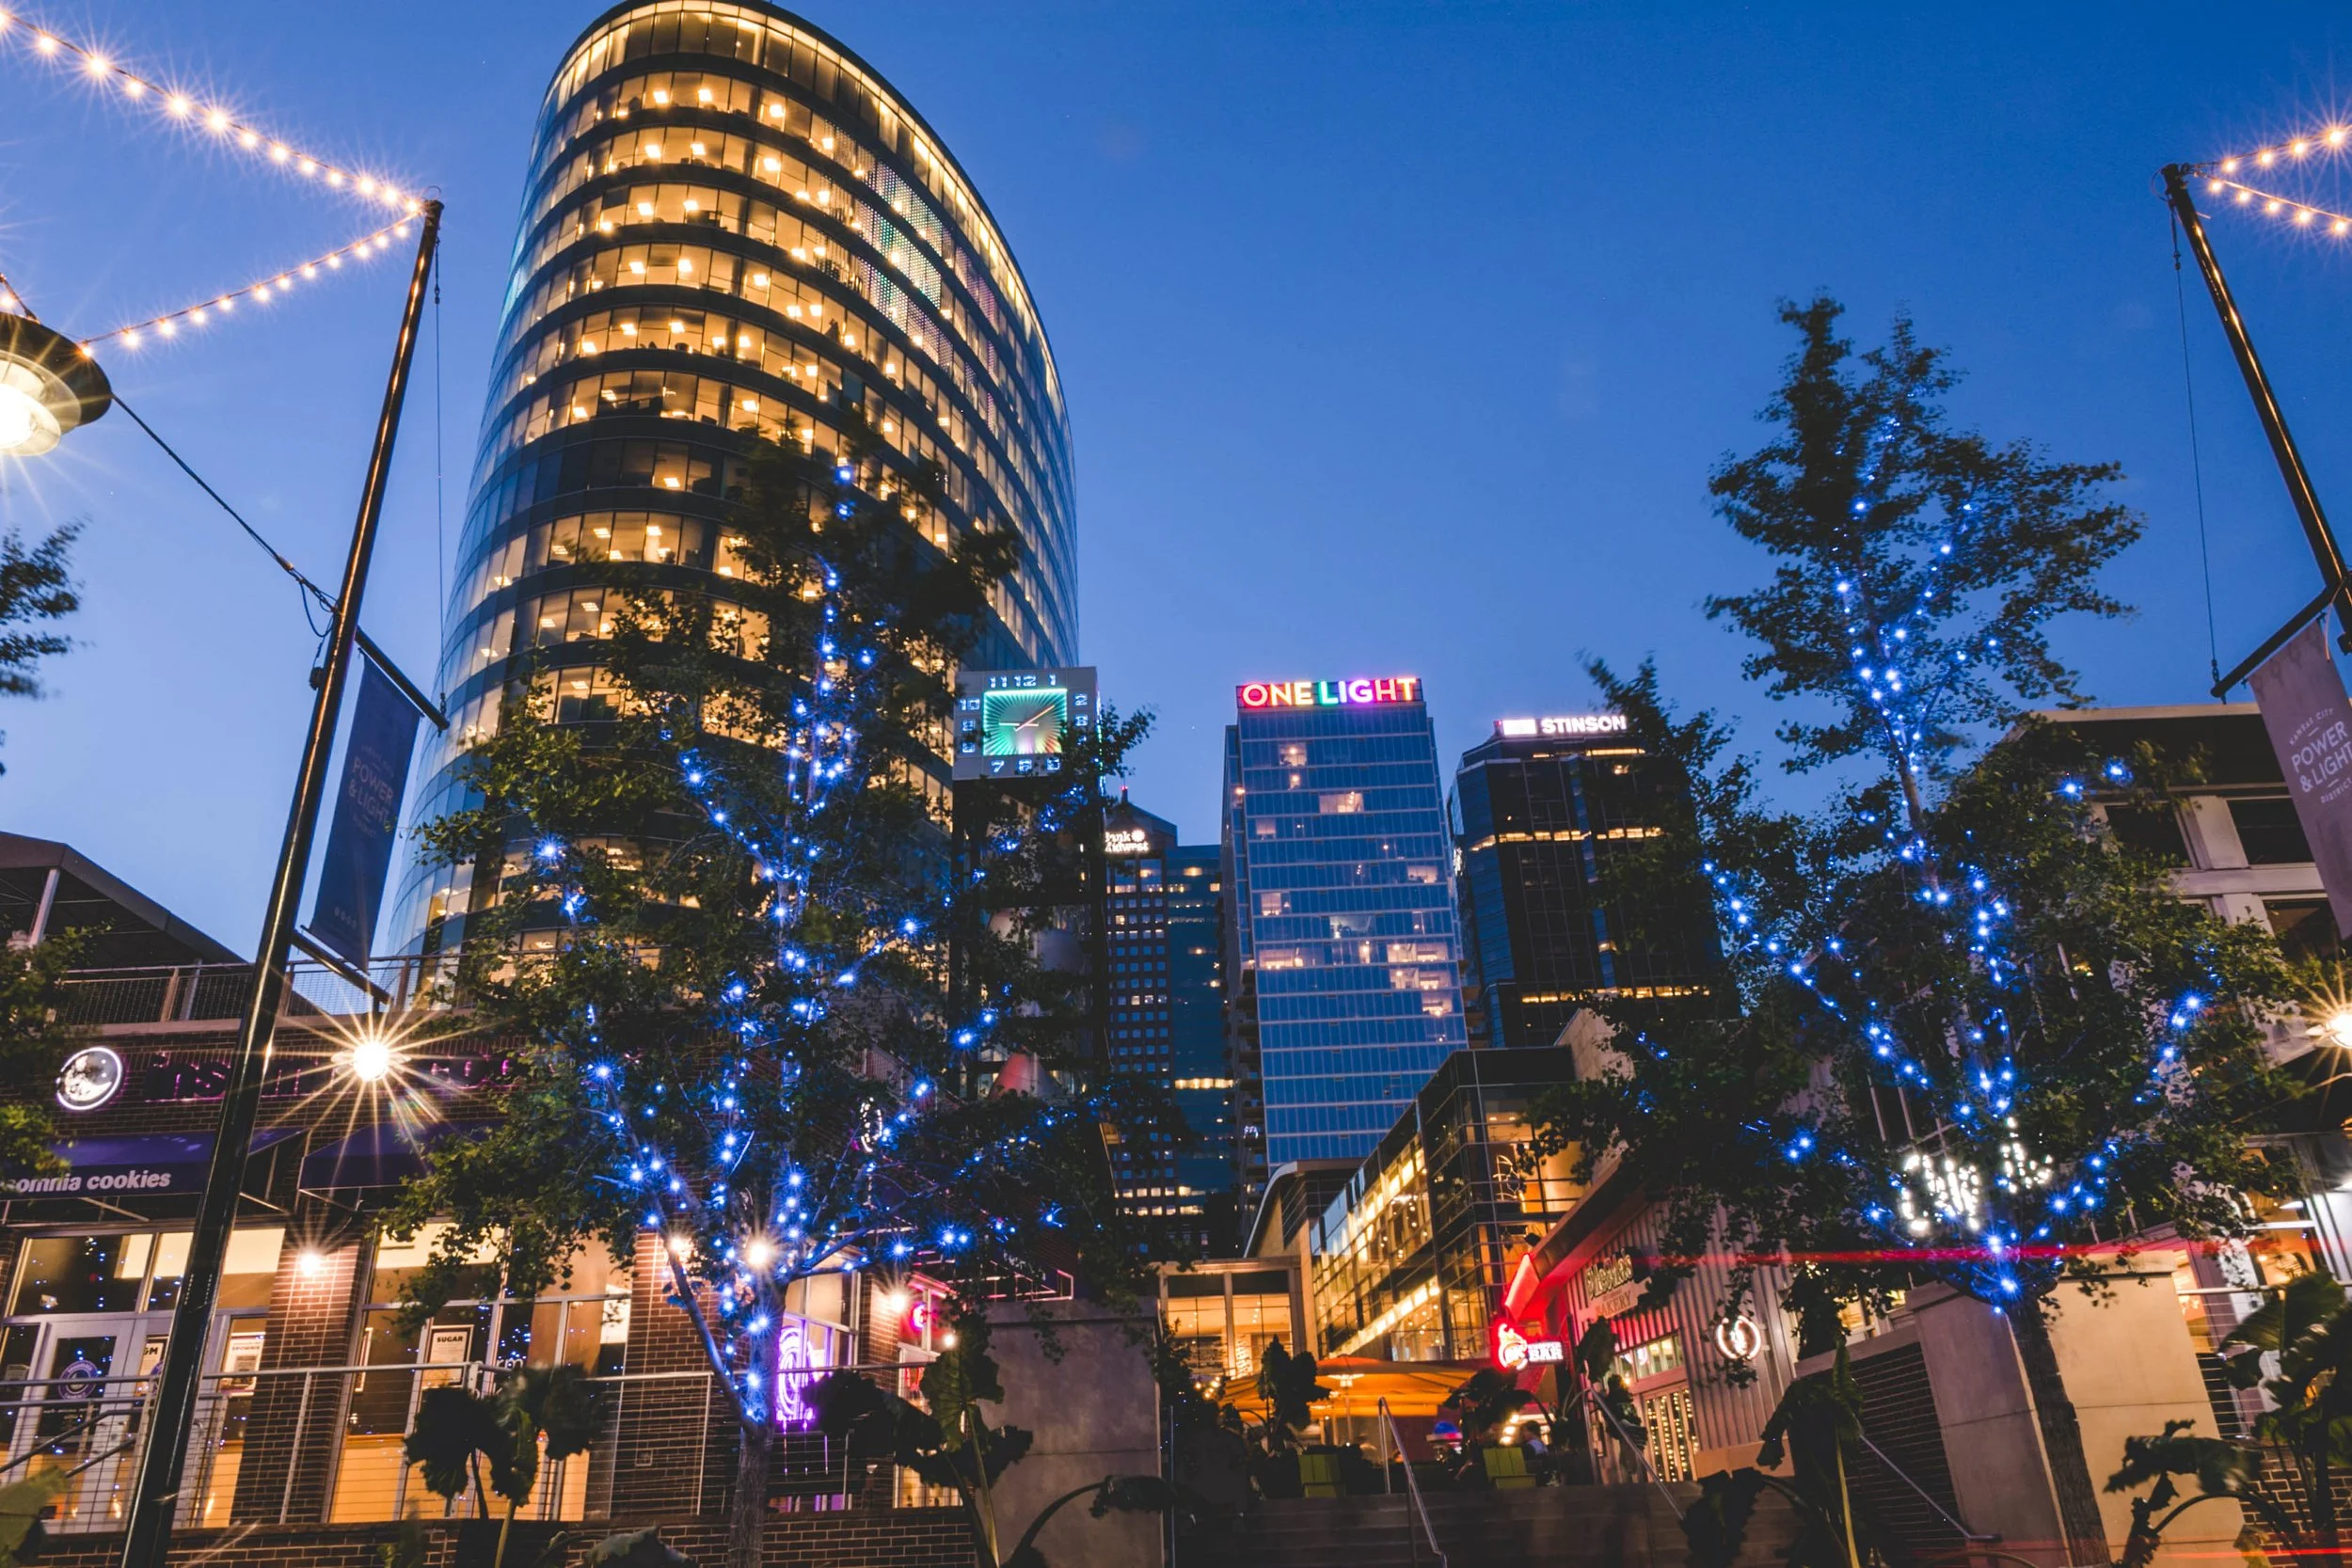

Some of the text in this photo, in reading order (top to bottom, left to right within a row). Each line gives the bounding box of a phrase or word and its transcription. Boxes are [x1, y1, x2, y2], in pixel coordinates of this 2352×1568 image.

[990, 675, 1008, 688] 11
[1014, 674, 1037, 687] 12
[1049, 673, 1057, 686] 1
[1074, 694, 1088, 706] 2
[1242, 676, 1416, 706] ONE LIGHT
[1541, 715, 1628, 734] STINSON
[2291, 721, 2348, 773] POWER
[991, 760, 1005, 773] 7
[2311, 741, 2352, 785] LIGHT
[353, 755, 394, 804] POWER
[358, 786, 390, 824] LIGHT
[87, 1169, 171, 1190] cookies
